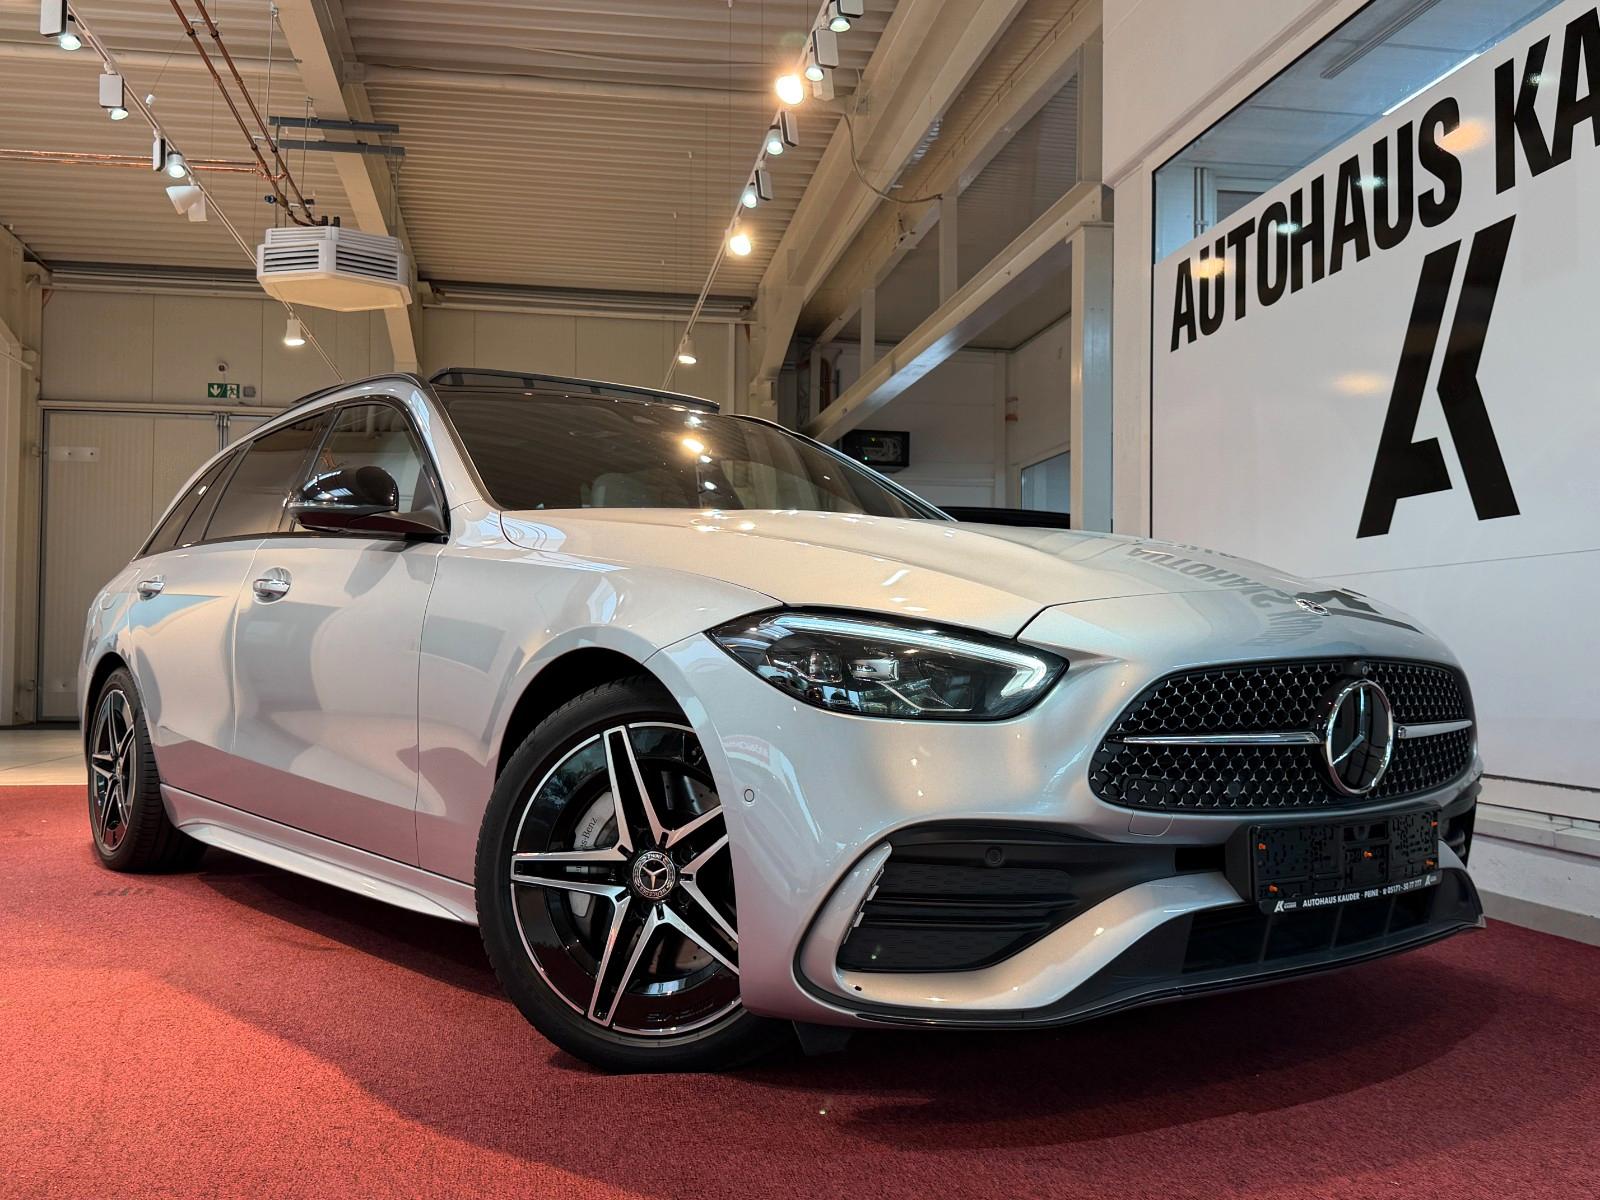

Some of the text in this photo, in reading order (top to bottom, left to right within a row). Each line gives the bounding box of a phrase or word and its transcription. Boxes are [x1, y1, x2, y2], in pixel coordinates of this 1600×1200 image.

[1171, 97, 1463, 353] AUTOHAUS
[1302, 895, 1336, 908] AUTOHAUS
[1337, 892, 1360, 903] KAUDER
